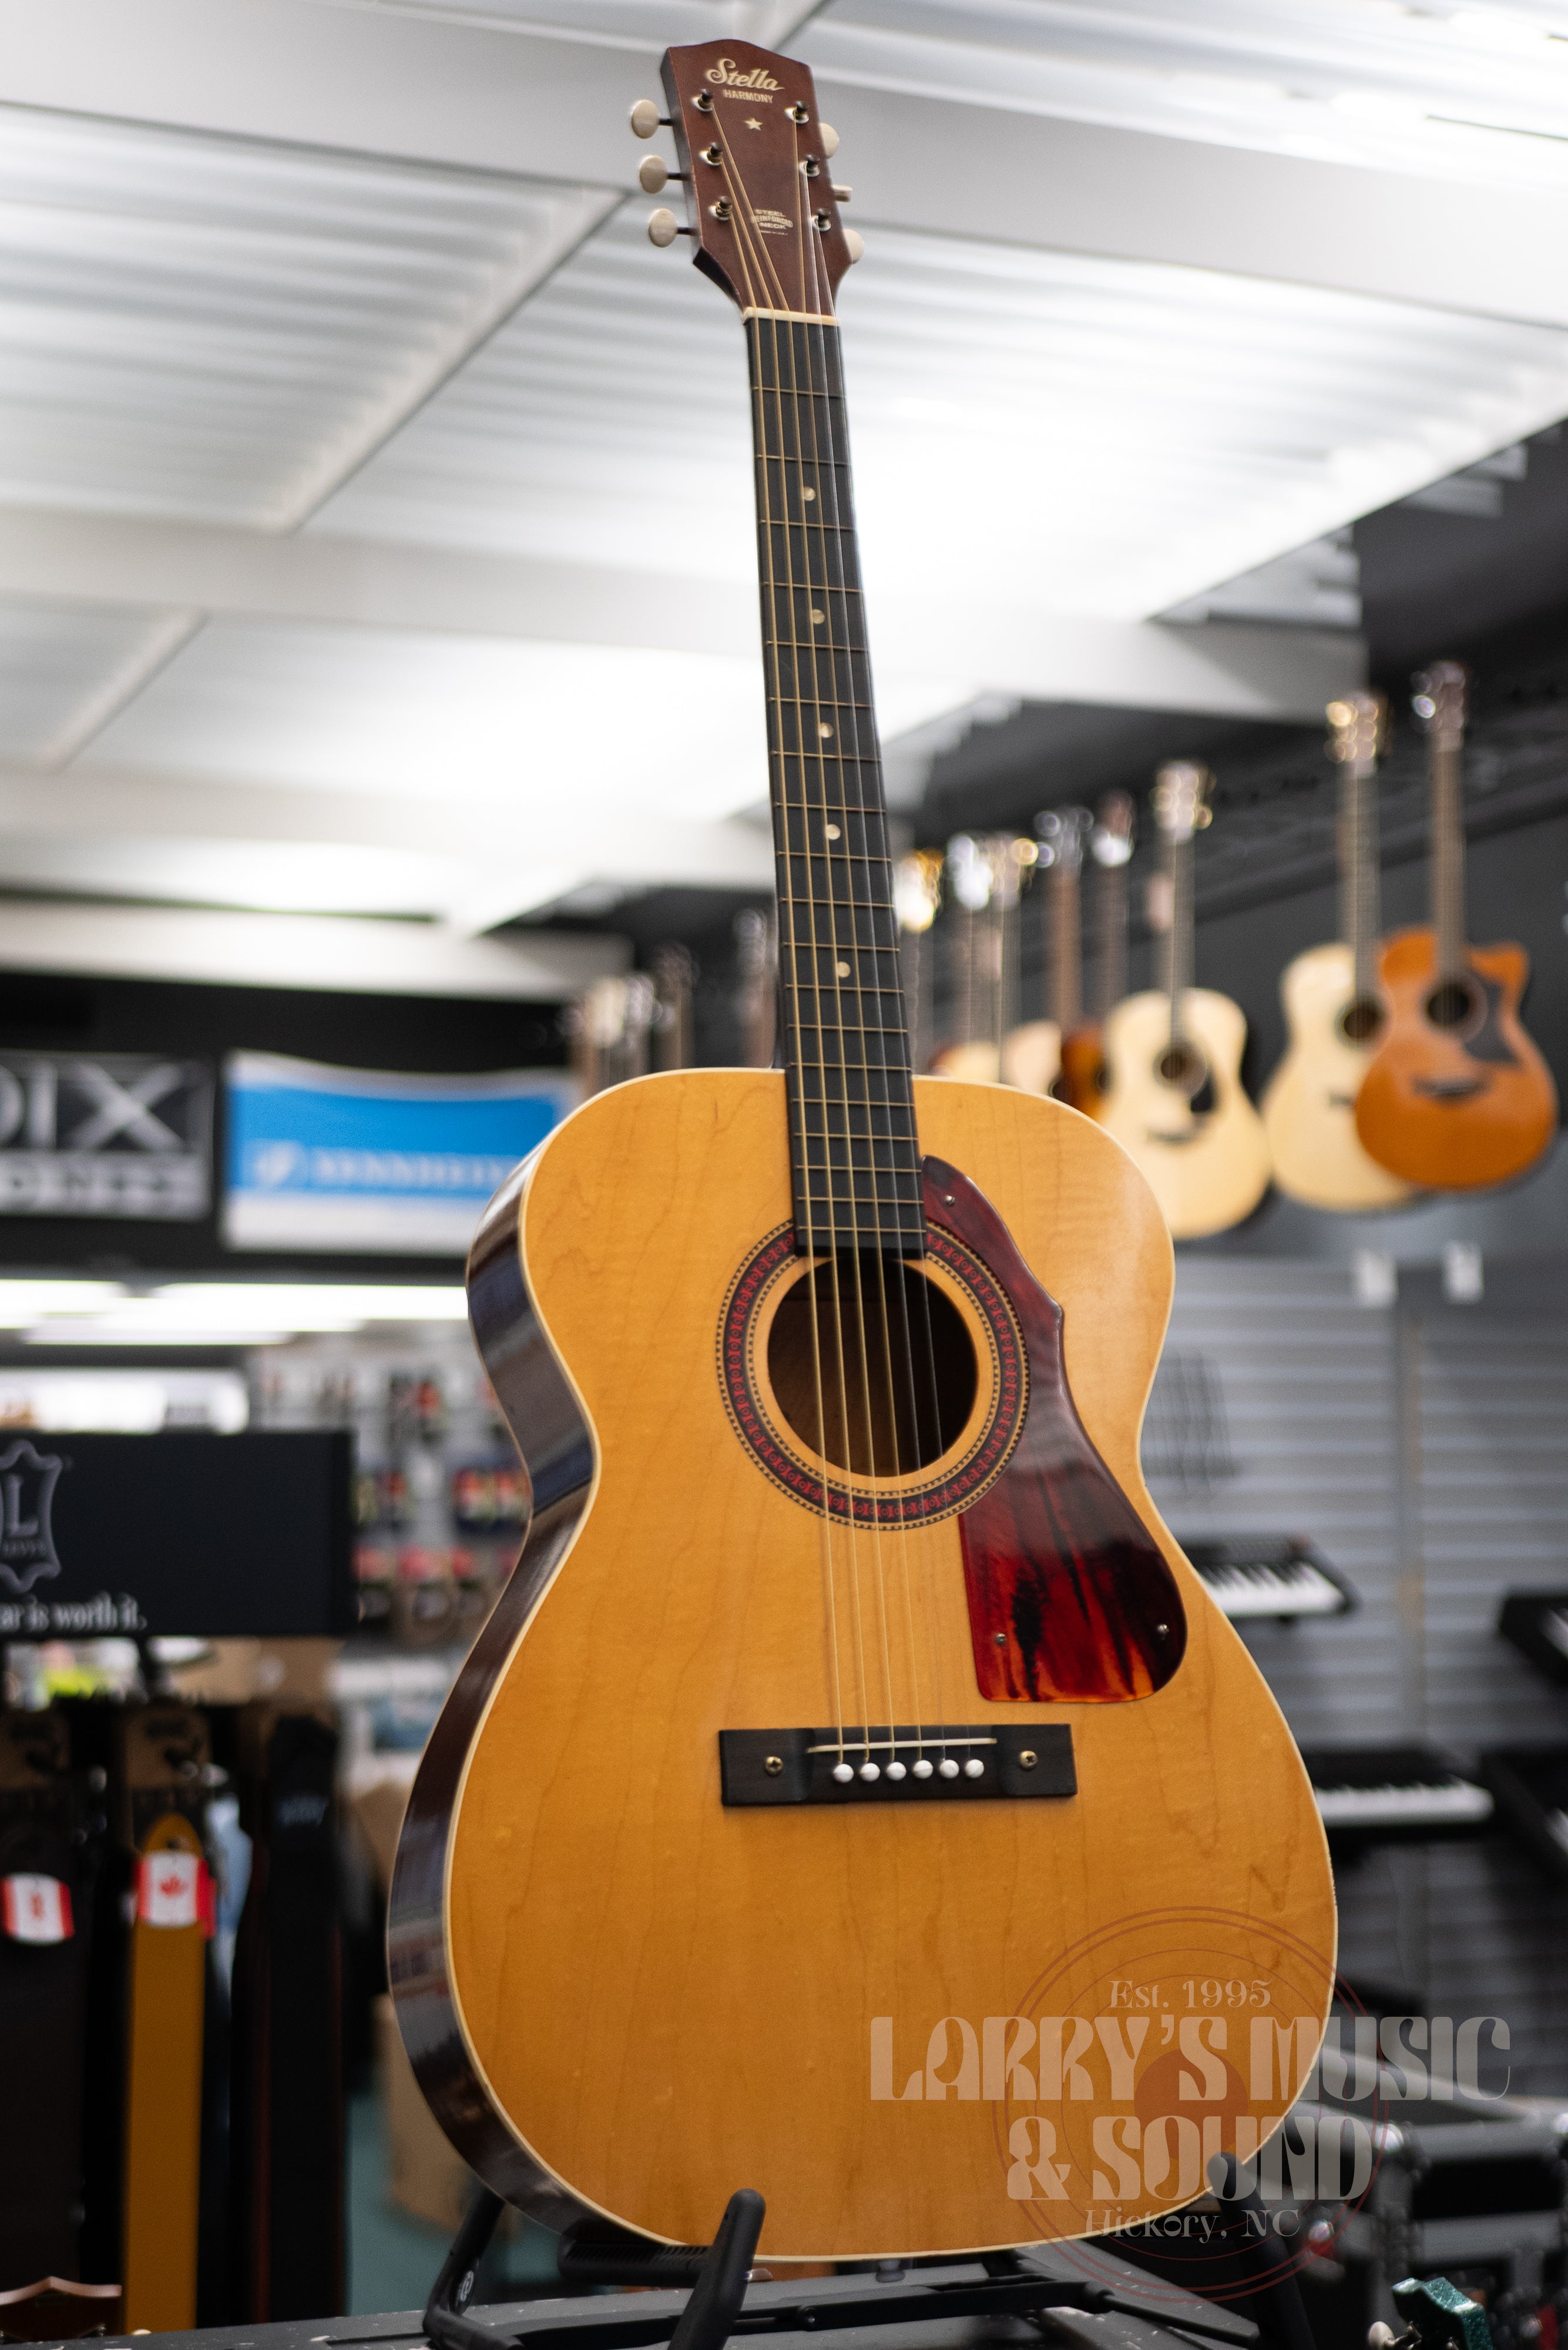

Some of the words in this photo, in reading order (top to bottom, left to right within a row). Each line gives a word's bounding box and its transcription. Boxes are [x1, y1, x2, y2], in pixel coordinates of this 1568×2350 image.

[706, 59, 785, 90] Stella
[722, 89, 773, 103] HARMONY
[54, 1591, 117, 1632] worth
